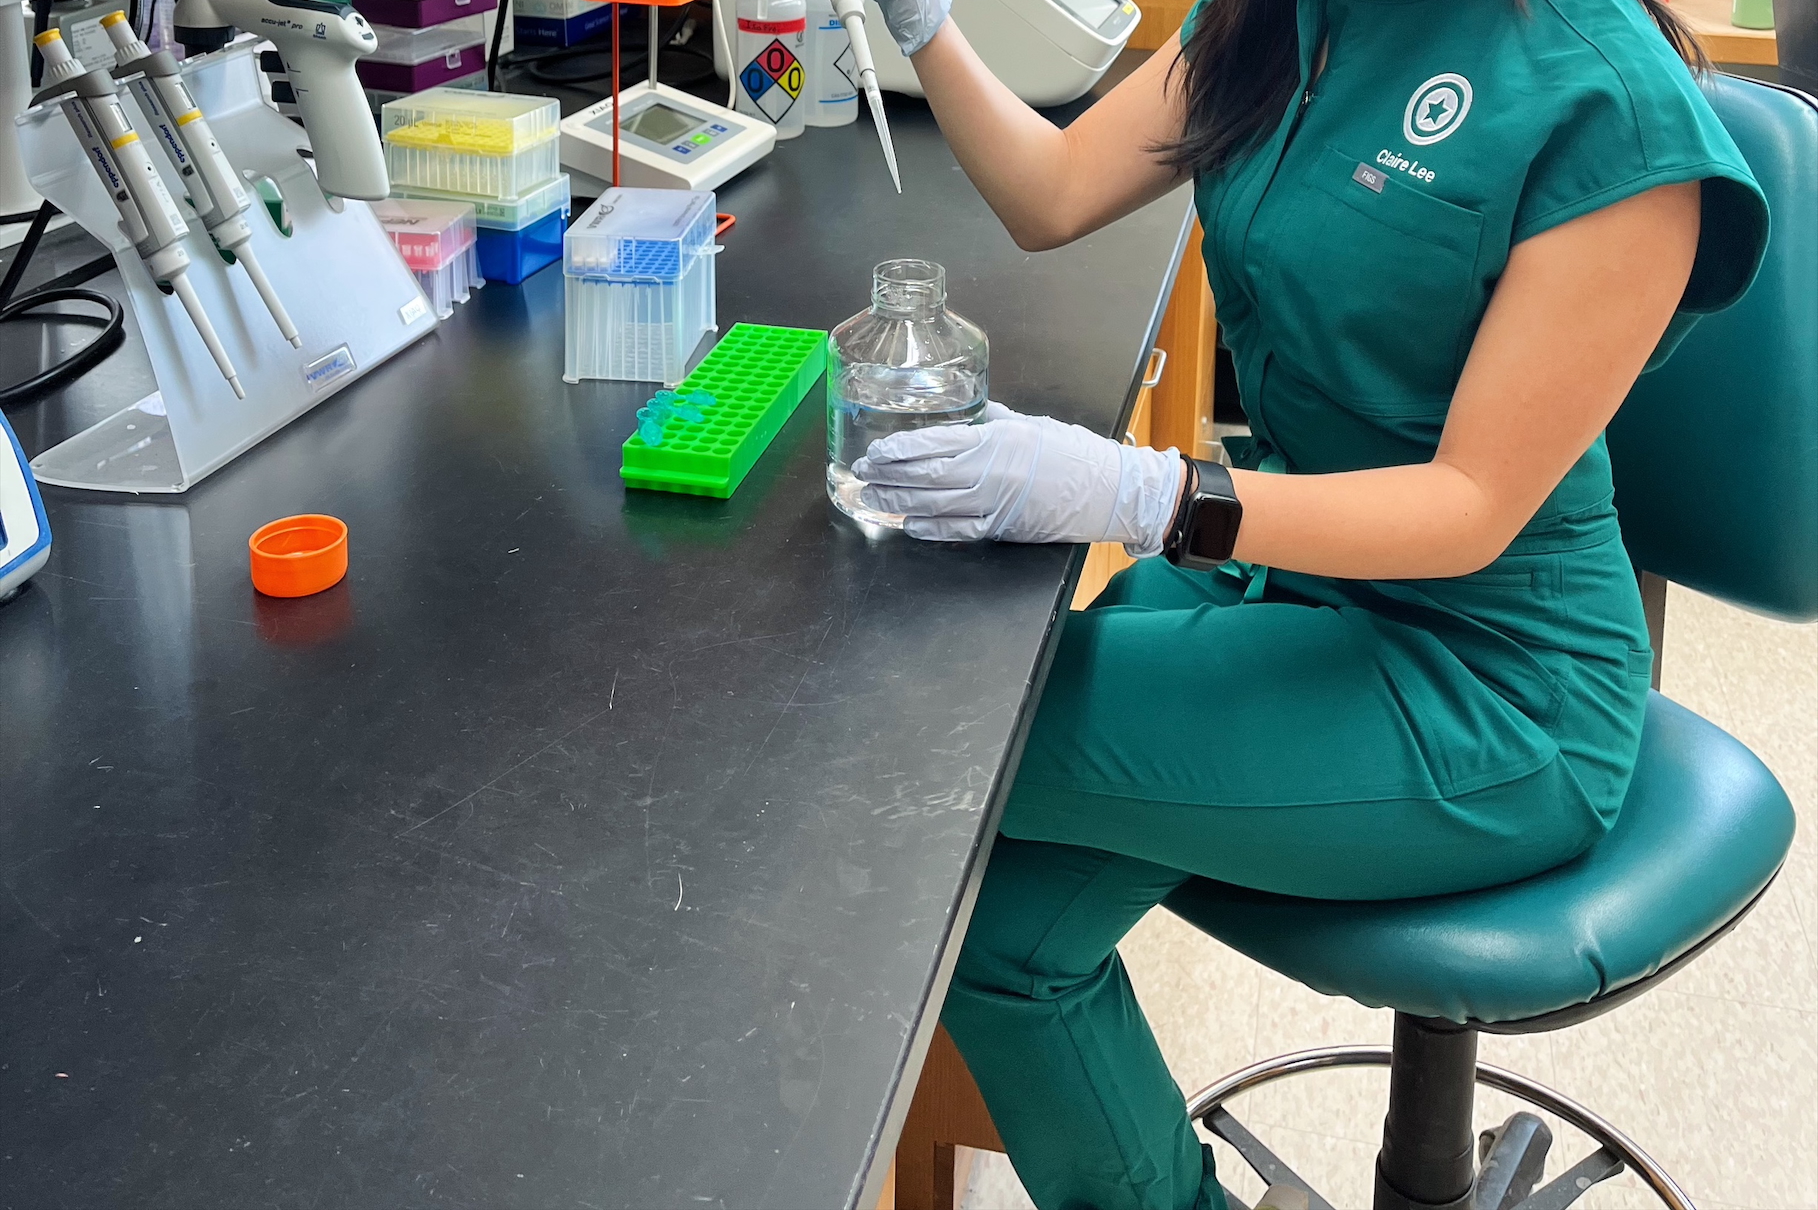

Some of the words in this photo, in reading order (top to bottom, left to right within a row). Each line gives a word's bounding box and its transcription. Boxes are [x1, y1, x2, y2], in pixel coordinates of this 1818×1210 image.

[291, 22, 304, 30] pro
[767, 47, 785, 73] 0
[748, 67, 764, 93] 0
[788, 66, 801, 92] 0
[395, 115, 406, 127] 20
[159, 123, 186, 164] eppendorf
[92, 146, 119, 189] eppendorf
[1361, 170, 1377, 185] FIGS
[1376, 149, 1410, 172] Claire
[1408, 160, 1436, 183] Lee
